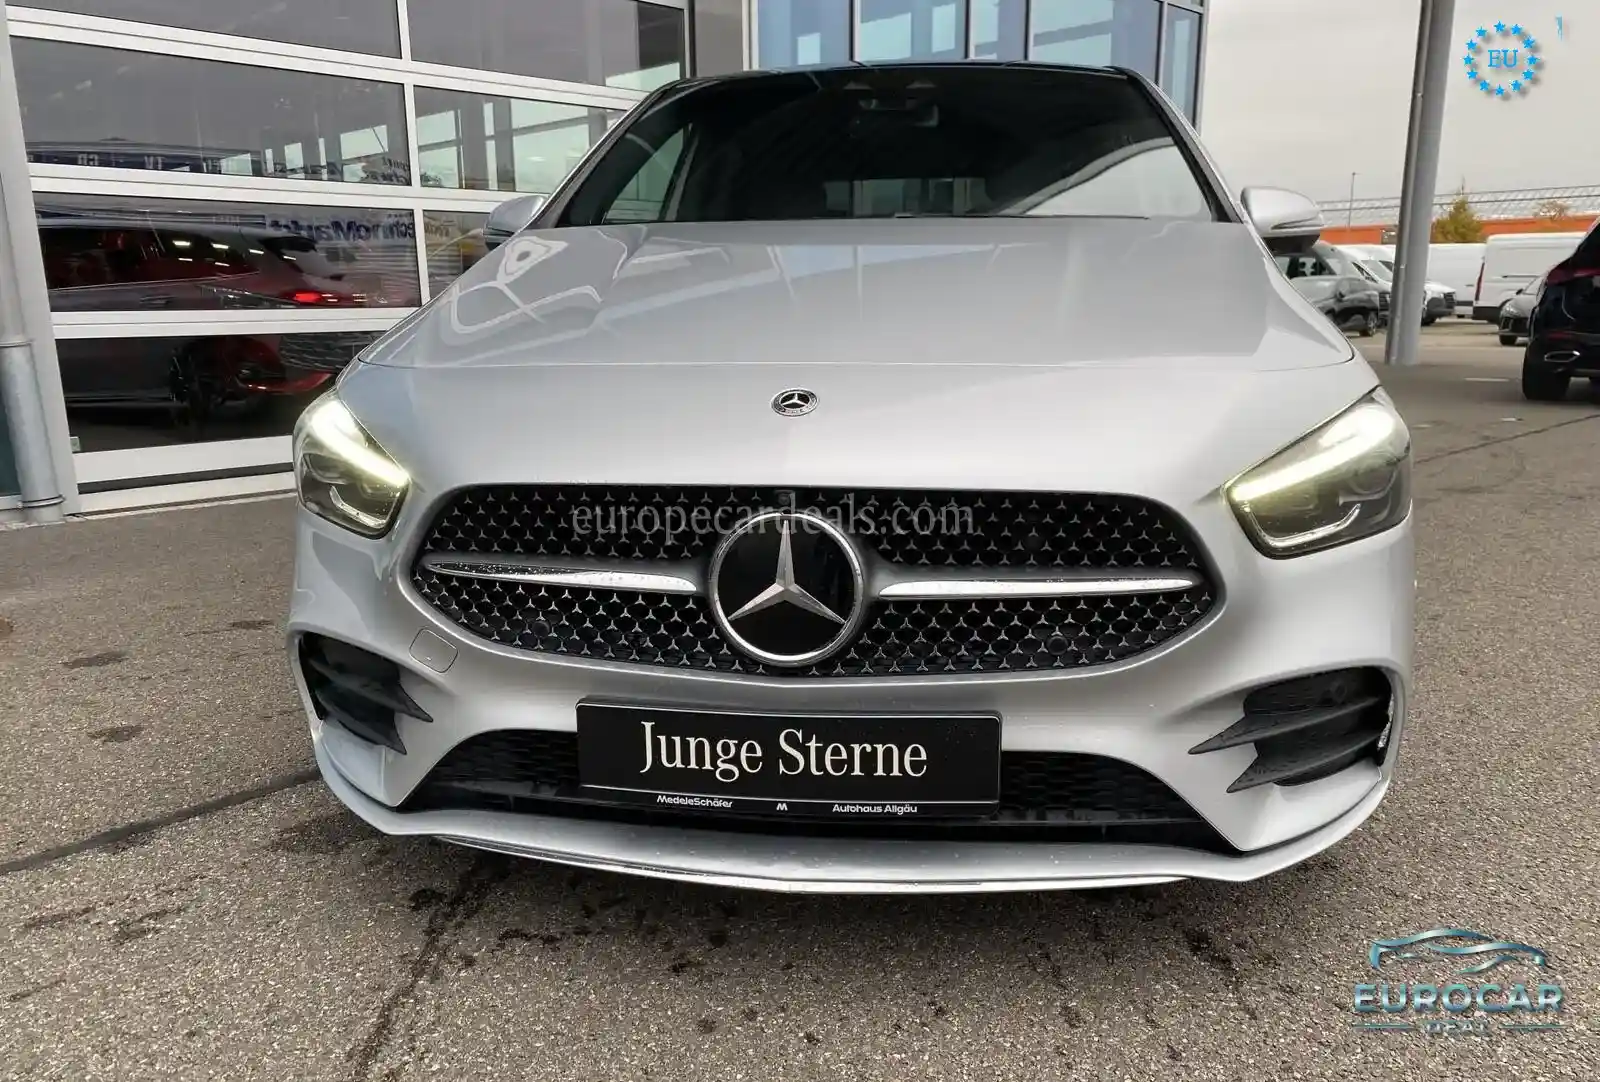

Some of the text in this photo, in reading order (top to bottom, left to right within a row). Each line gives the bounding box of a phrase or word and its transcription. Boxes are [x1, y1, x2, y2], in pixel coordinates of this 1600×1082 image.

[639, 720, 928, 783] Junge Sterne
[656, 794, 734, 809] MedeleSchäfer
[832, 803, 918, 815] Autohaus Allgäu
